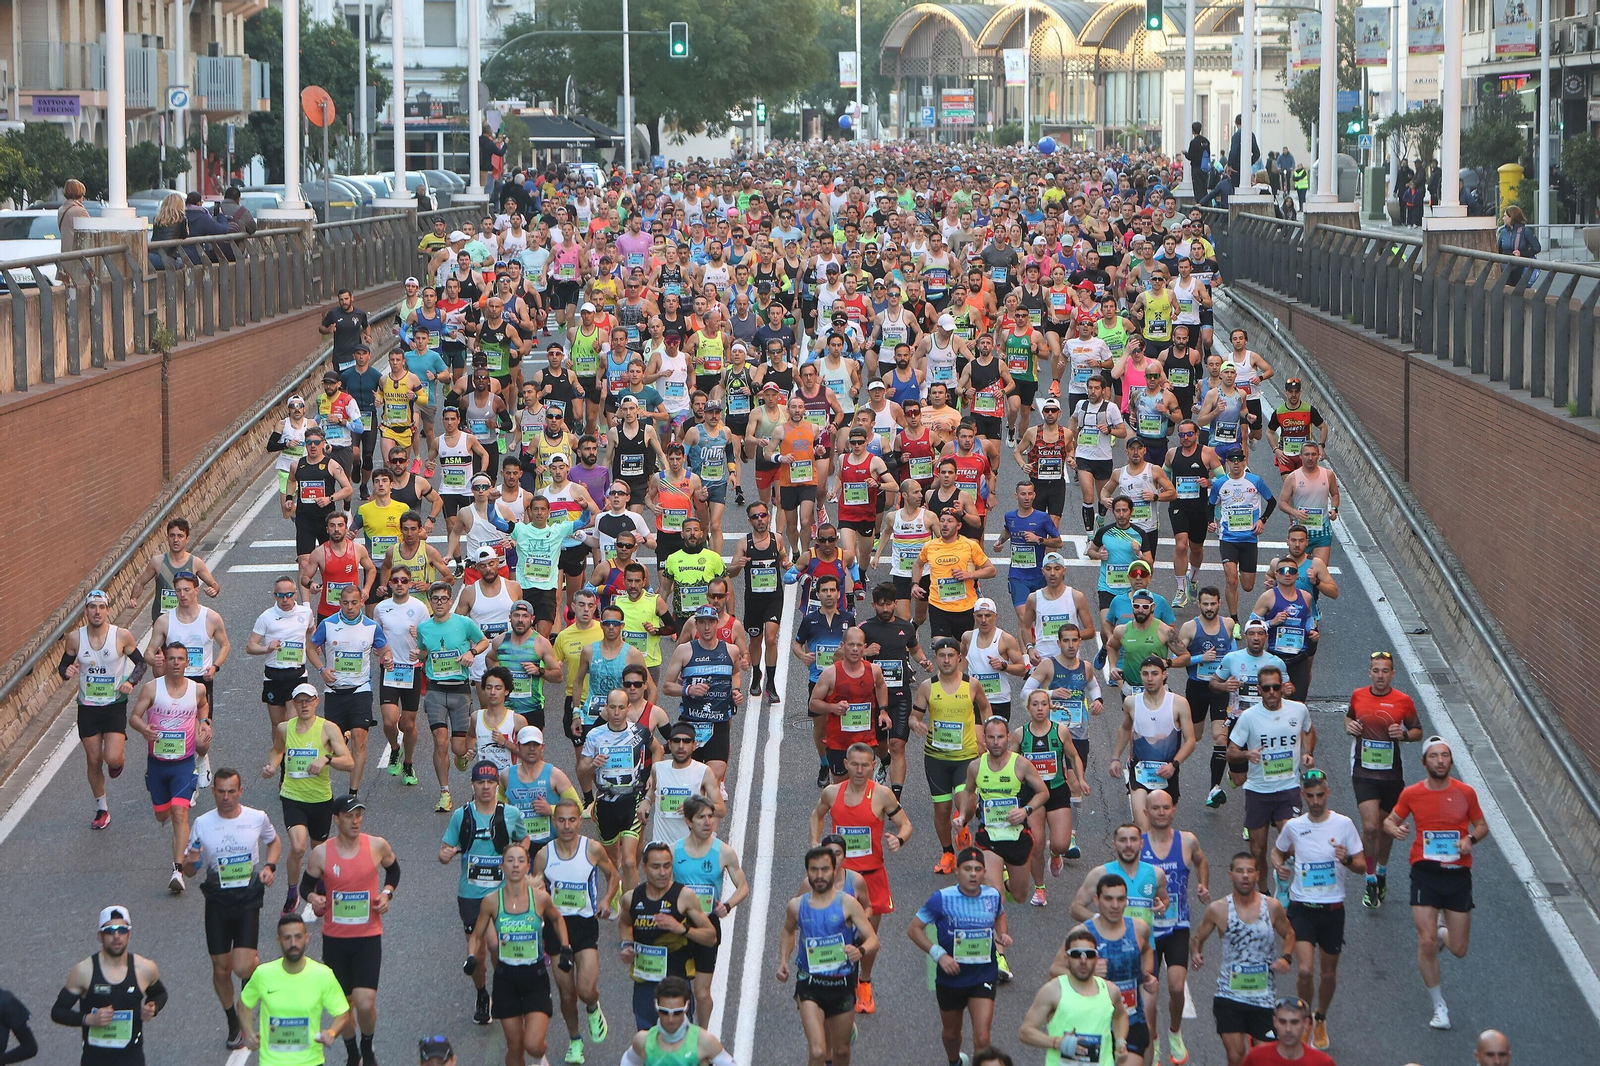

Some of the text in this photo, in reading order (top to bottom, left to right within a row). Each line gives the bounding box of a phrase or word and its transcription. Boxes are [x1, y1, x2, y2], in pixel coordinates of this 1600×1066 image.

[923, 109, 931, 120] P
[689, 709, 724, 721] Veldenburg
[225, 845, 248, 853] Quinta
[230, 855, 249, 863] ZURICH
[819, 938, 840, 946] ZURICH
